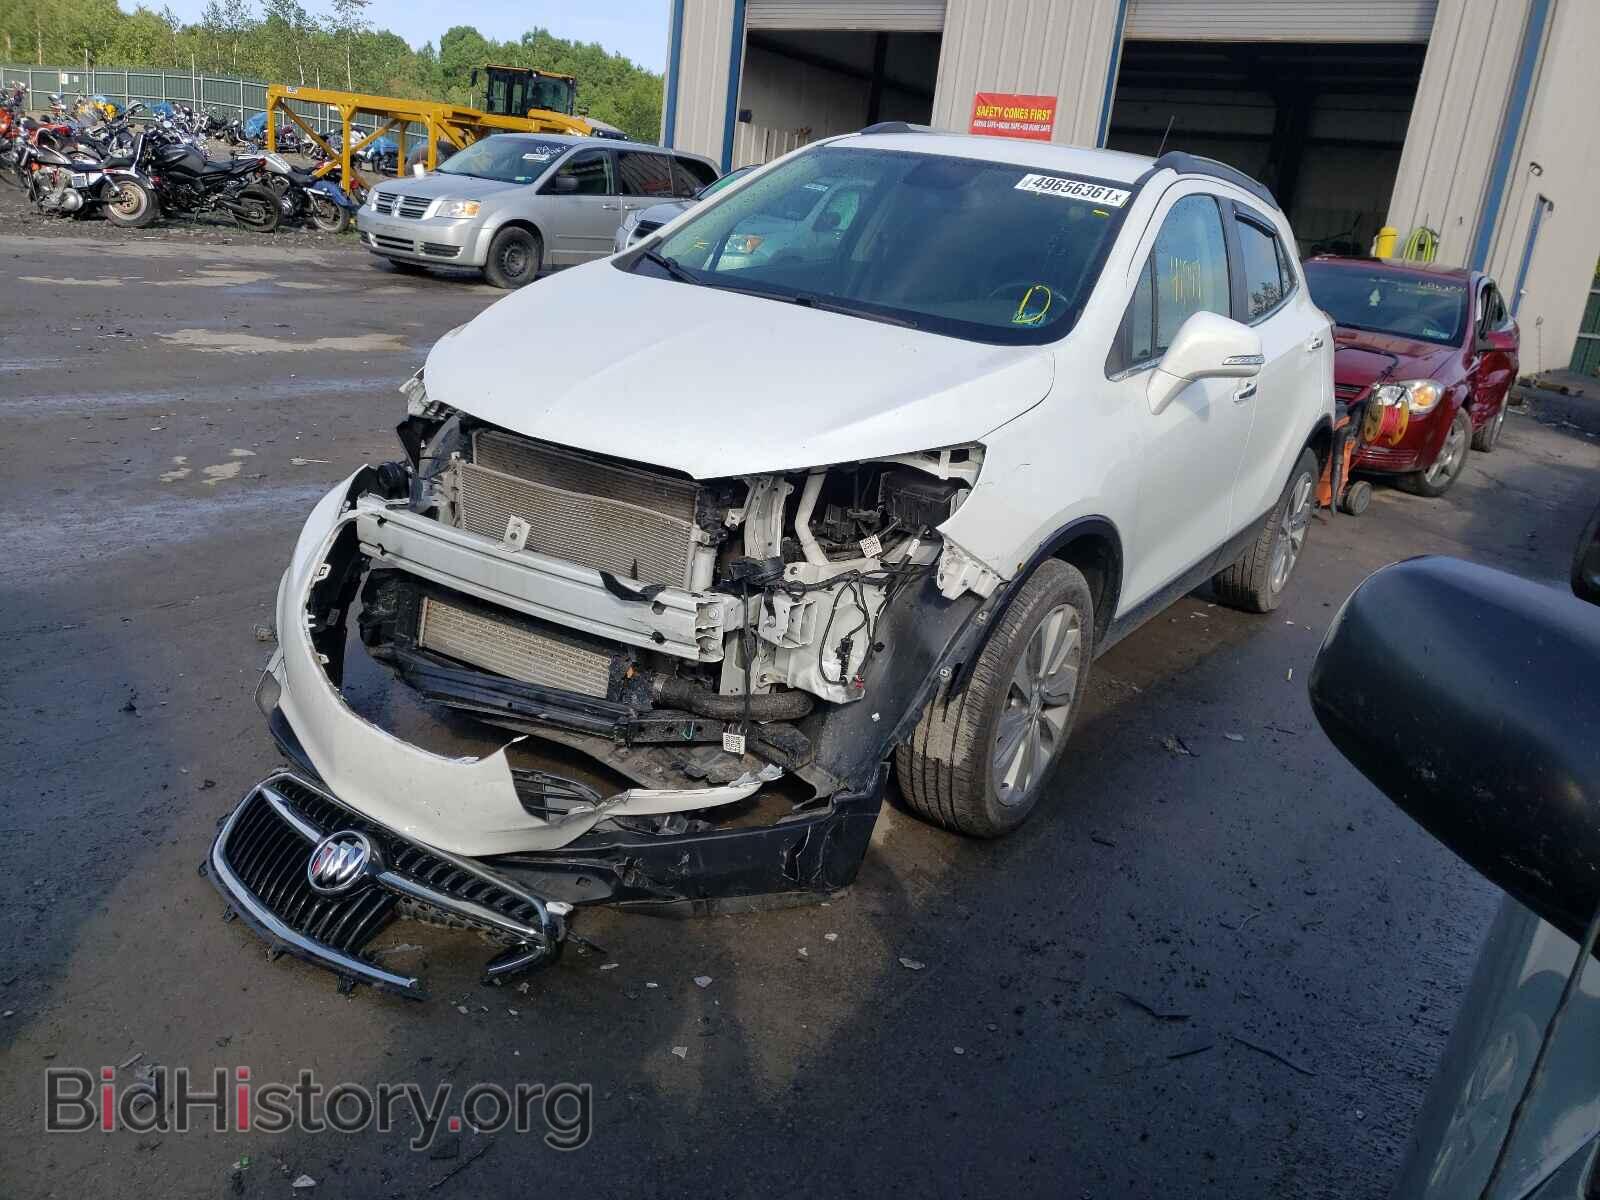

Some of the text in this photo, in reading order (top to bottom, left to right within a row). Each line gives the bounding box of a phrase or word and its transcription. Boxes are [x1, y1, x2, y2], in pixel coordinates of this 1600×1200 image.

[976, 105, 1052, 121] SAFETY COMES FIRST
